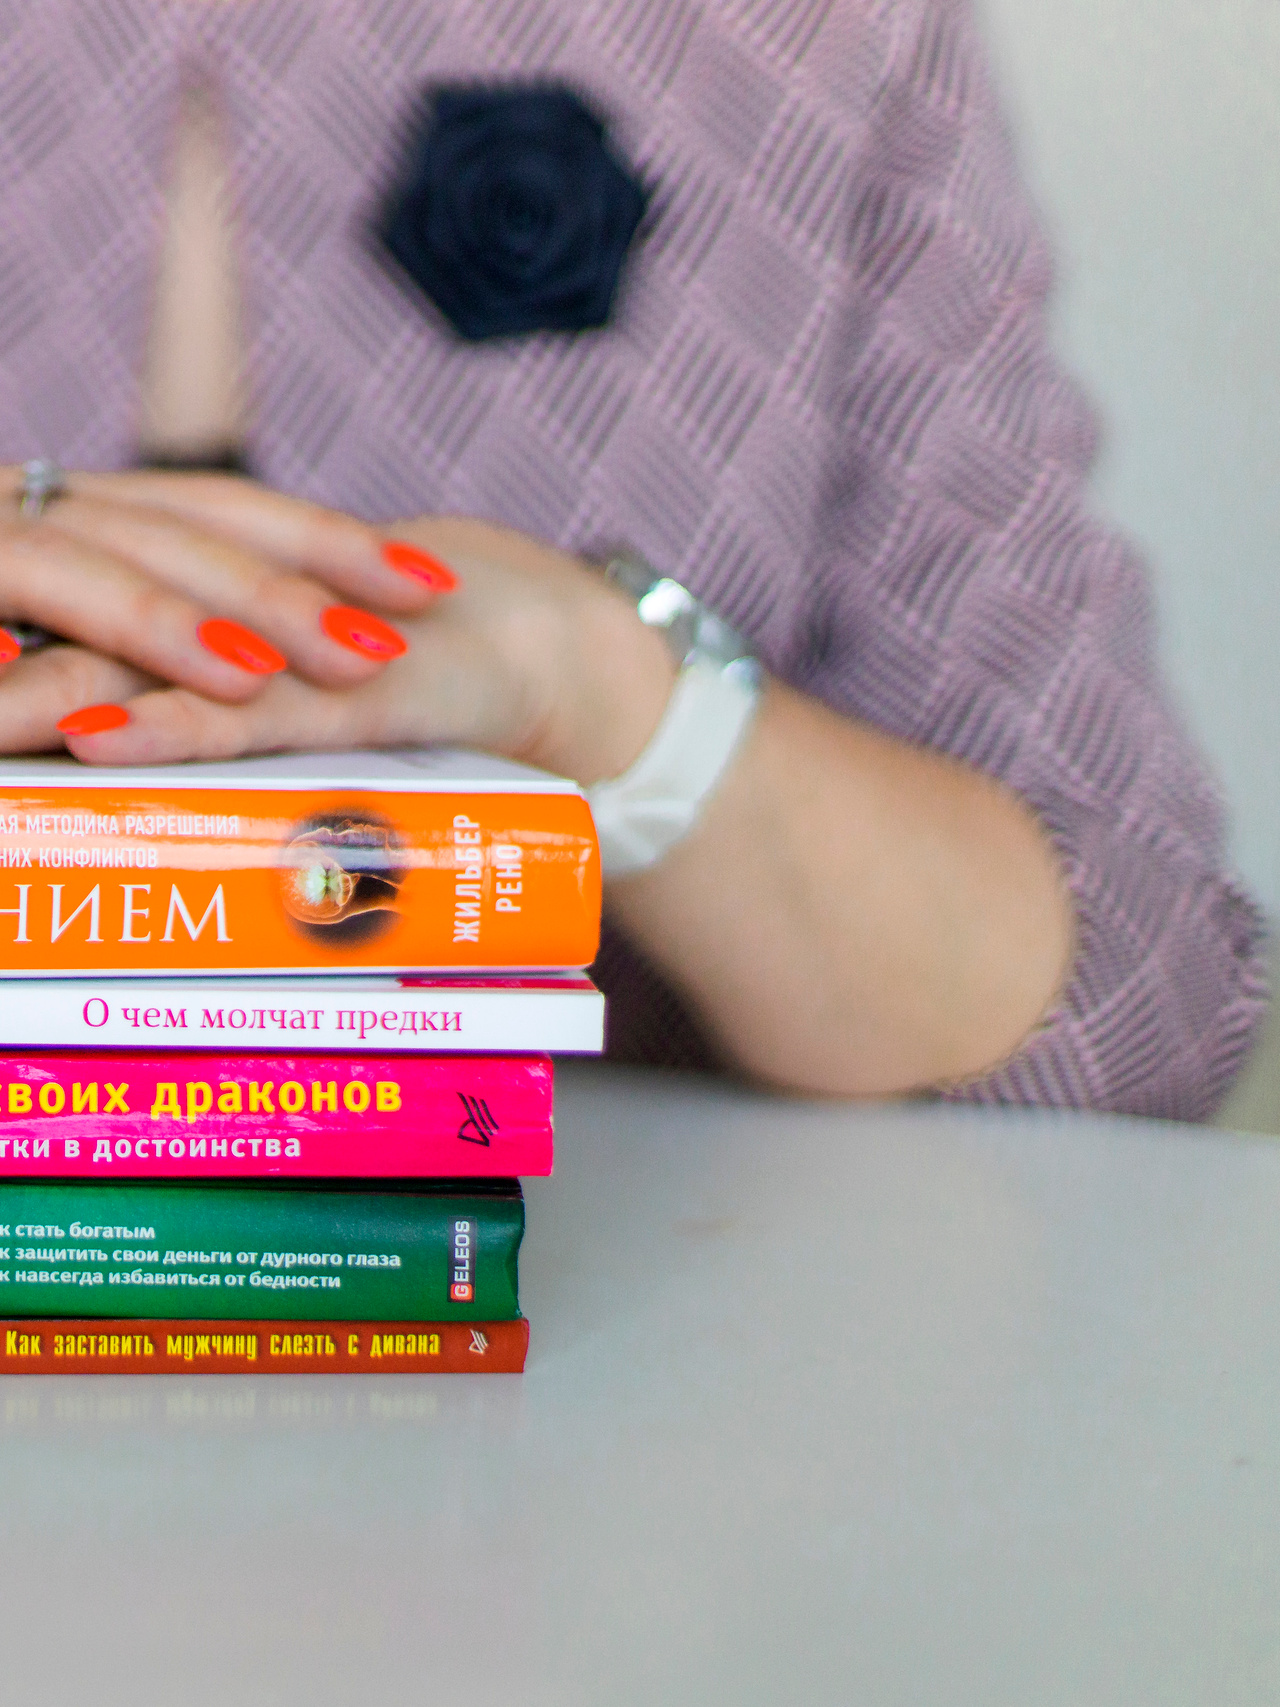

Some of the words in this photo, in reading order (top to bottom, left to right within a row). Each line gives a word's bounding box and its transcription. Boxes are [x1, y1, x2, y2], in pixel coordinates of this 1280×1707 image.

[25, 813, 119, 838] МЕТОДИКА
[125, 813, 240, 838] РАЗРЕШЕНИЯ
[38, 845, 159, 870] КОНФЛИКТОВ
[452, 814, 481, 944] ЖИЛЬБЕР
[495, 844, 523, 913] РЕНО
[82, 998, 110, 1029] О
[121, 1007, 189, 1030] чем
[200, 1007, 324, 1030] молчат
[334, 1009, 463, 1036] предки
[150, 1079, 401, 1123] драконов
[63, 1138, 81, 1158] в
[92, 1136, 301, 1162] достоинства
[15, 1223, 65, 1239] стать
[69, 1221, 156, 1239] богатым
[15, 1246, 108, 1263] защитить
[112, 1248, 159, 1264] свои
[163, 1250, 232, 1267] деньги
[236, 1252, 258, 1266] от
[261, 1252, 342, 1269] дурного
[347, 1253, 402, 1267] глаза
[453, 1219, 471, 1298] GELEOS
[15, 1270, 104, 1286] навсегда
[109, 1269, 220, 1286] избавиться
[224, 1273, 246, 1287] от
[250, 1270, 341, 1289] бедности
[6, 1332, 41, 1356] Как
[54, 1333, 154, 1357] заставить
[166, 1334, 257, 1361] мужчину
[269, 1333, 336, 1356] слезть
[348, 1334, 359, 1355] с
[369, 1334, 441, 1358] дивана
